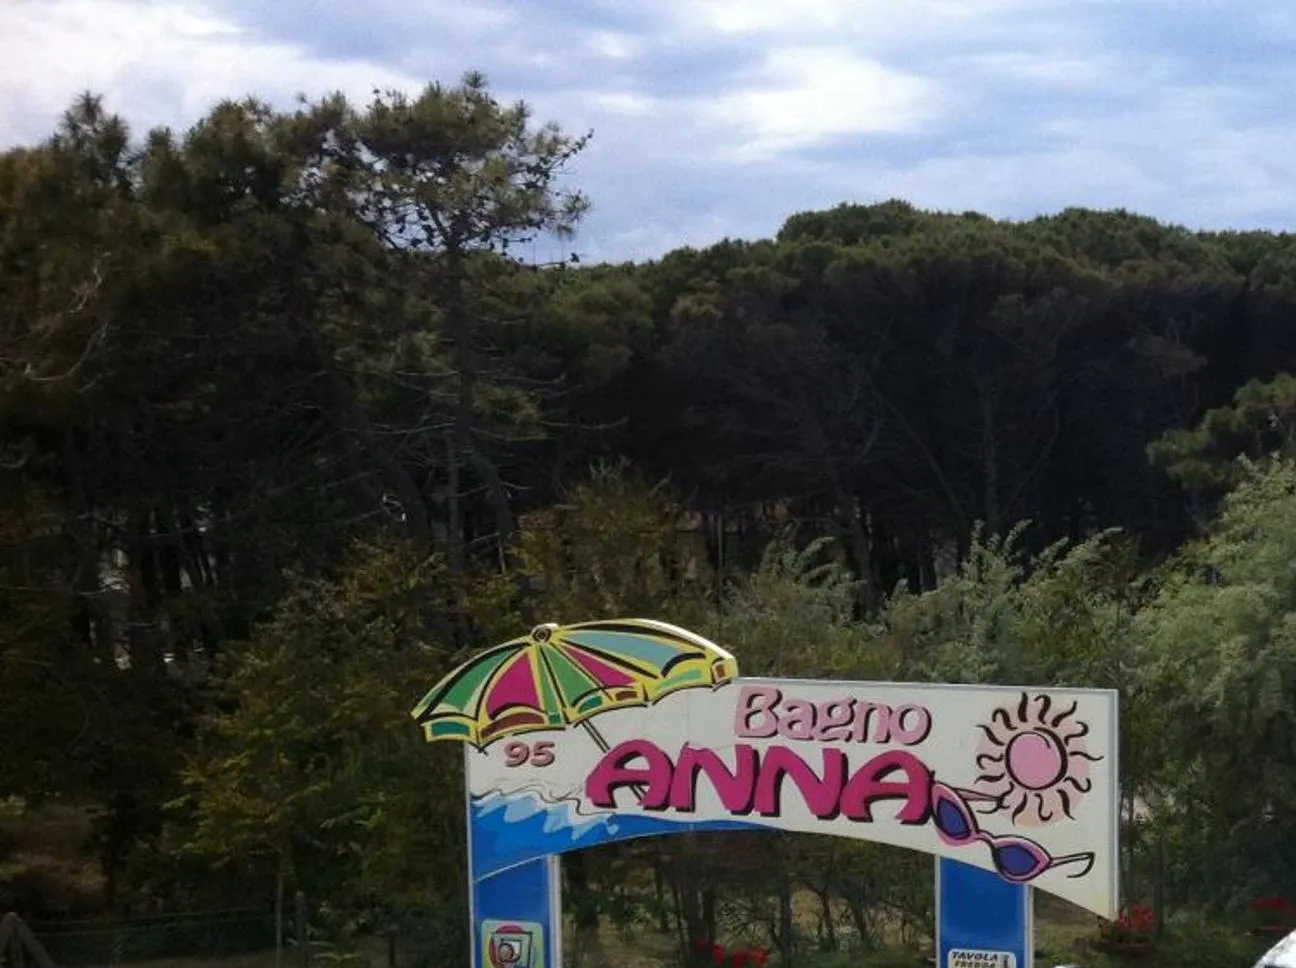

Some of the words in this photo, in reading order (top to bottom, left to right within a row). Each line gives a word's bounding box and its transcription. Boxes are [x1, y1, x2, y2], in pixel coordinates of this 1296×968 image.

[733, 684, 932, 746] Bagno
[502, 740, 556, 768] 95
[584, 738, 938, 826] ANNA
[951, 951, 999, 963] TAVOLA
